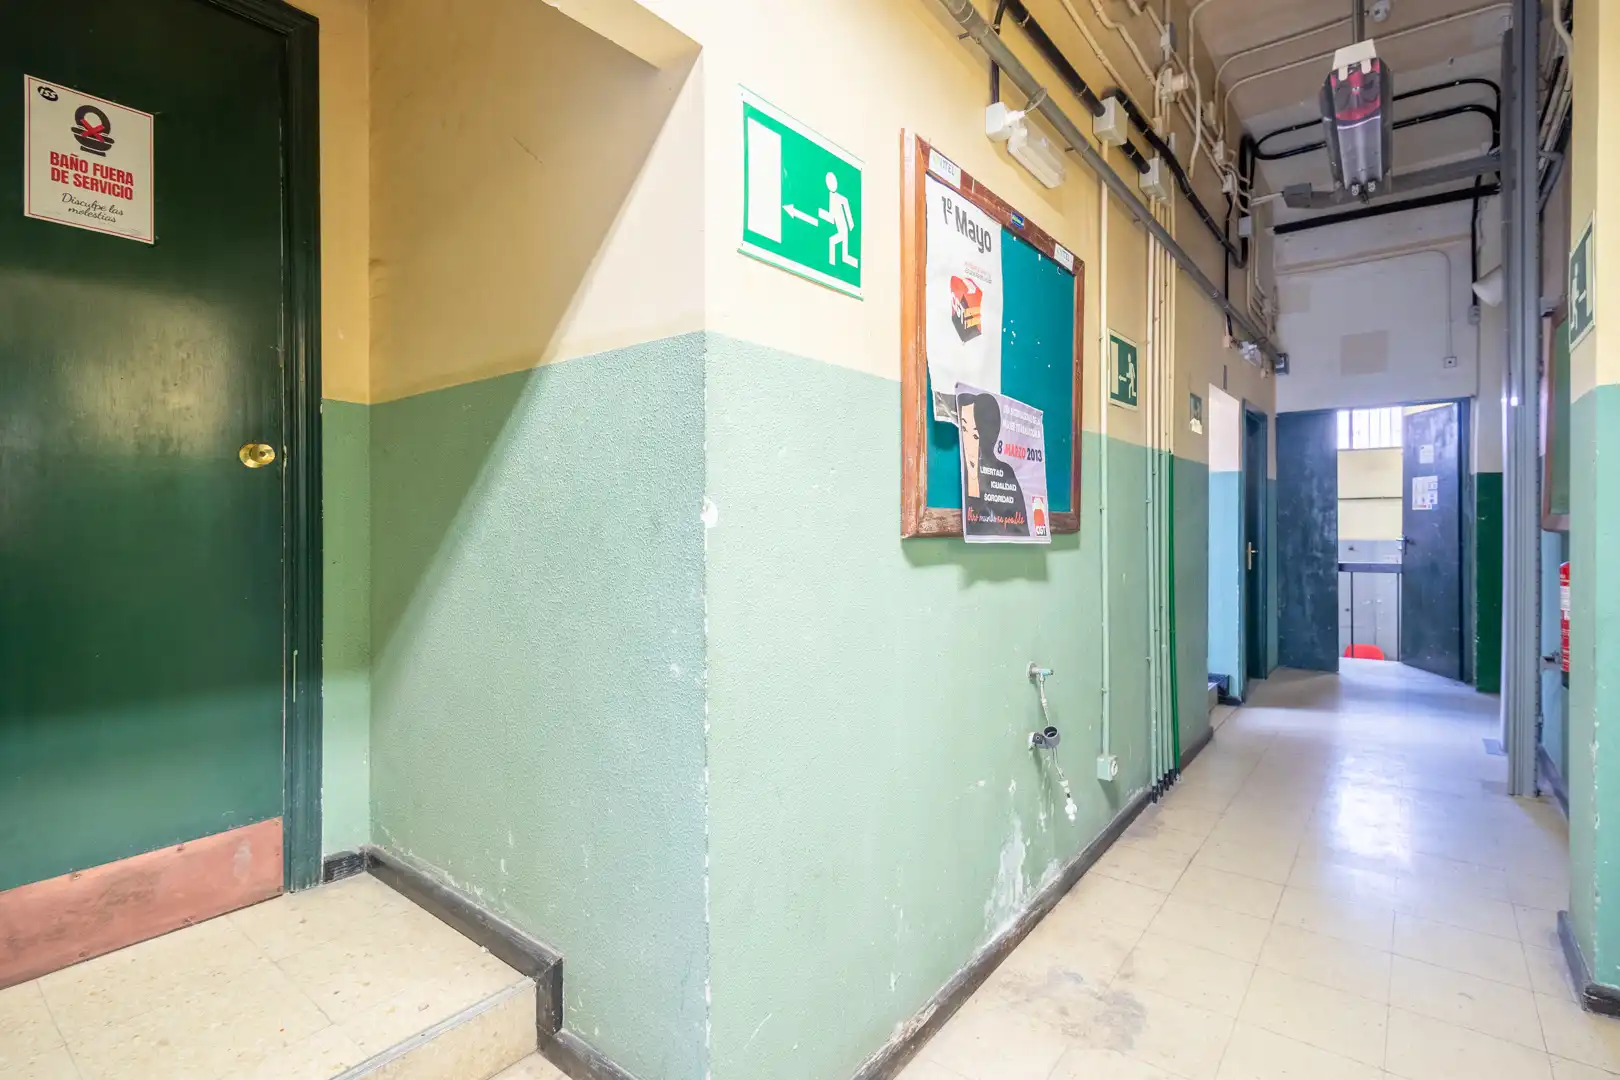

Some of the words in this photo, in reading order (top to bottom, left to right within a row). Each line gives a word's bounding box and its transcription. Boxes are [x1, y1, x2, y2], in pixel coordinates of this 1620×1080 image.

[50, 151, 88, 173] BAÑO
[93, 162, 134, 186] FUERA
[51, 167, 69, 184] DE
[73, 173, 133, 200] SERVICIO
[61, 192, 107, 211] Disculpe
[108, 204, 124, 216] las
[68, 207, 117, 222] molestias
[941, 196, 952, 225] 1º
[955, 205, 991, 254] Mayo
[997, 440, 1003, 454] 8
[1004, 443, 1026, 459] MARZO
[1027, 447, 1043, 462] 2013
[980, 466, 1004, 477] LIBERTAD
[984, 493, 1014, 503] SORORIDAD
[1035, 526, 1046, 535] CGT
